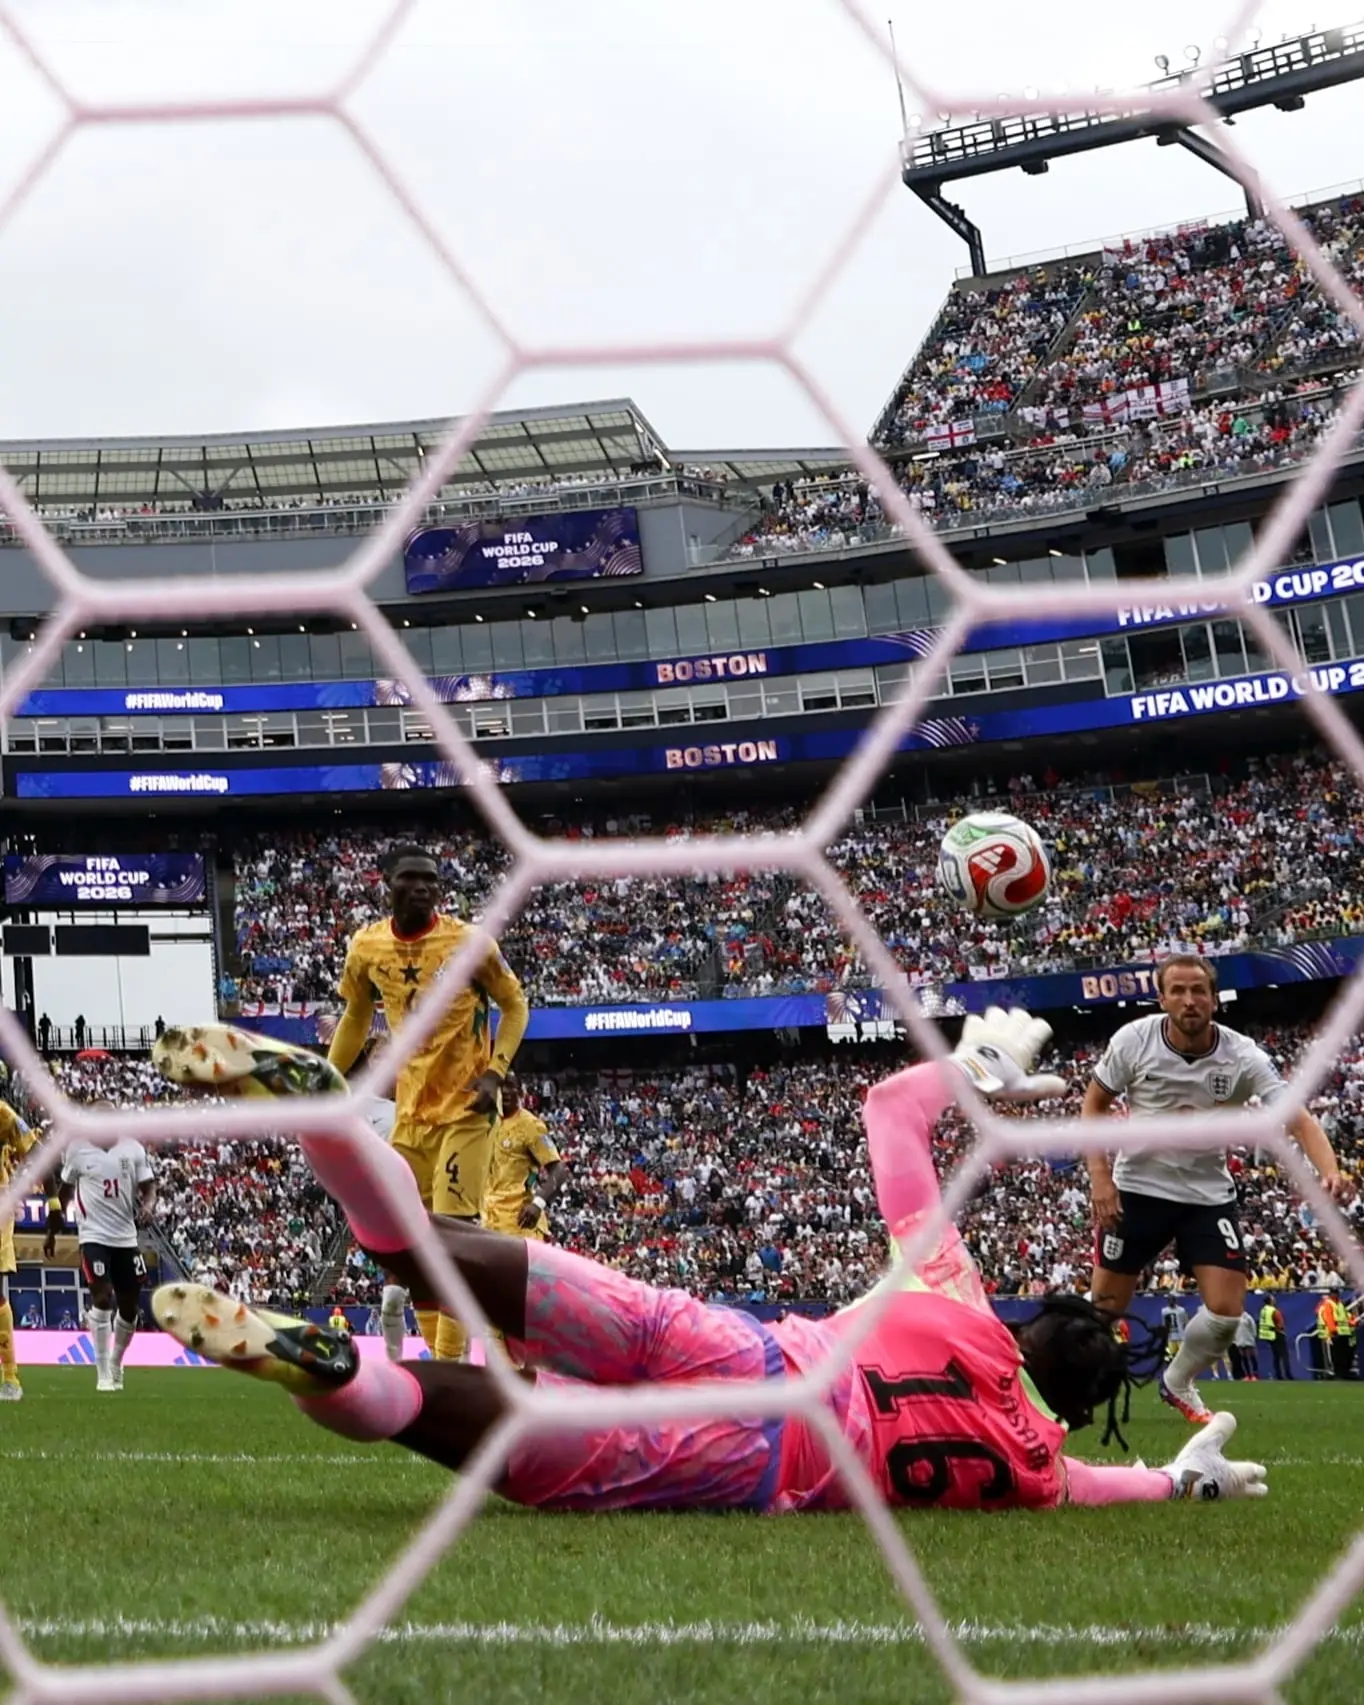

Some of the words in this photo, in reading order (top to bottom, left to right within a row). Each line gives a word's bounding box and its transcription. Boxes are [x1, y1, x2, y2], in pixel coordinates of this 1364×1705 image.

[503, 532, 533, 545] FIFA
[482, 544, 530, 558] WORLD
[531, 541, 558, 554] CUP
[497, 554, 544, 569] 2026
[1275, 571, 1329, 599] CUP
[656, 653, 767, 683] BOSTON
[125, 692, 223, 710] #FIFAWorldCup
[1131, 694, 1188, 720] FIFA
[1190, 677, 1288, 711] WORLD
[665, 740, 777, 769] BOSTON
[130, 774, 228, 793] #FIFAWorldCup
[86, 857, 120, 871] FIFA
[59, 872, 117, 886] WORLD
[118, 871, 150, 885] CUP
[77, 886, 132, 900] 2026
[1081, 969, 1159, 1000] BOST
[585, 1008, 691, 1030] #FIFAWorldCup
[445, 1152, 460, 1183] 4
[103, 1178, 119, 1198] 21
[1217, 1218, 1240, 1250] 9
[133, 1254, 147, 1275] 21
[858, 1356, 1016, 1502] 16
